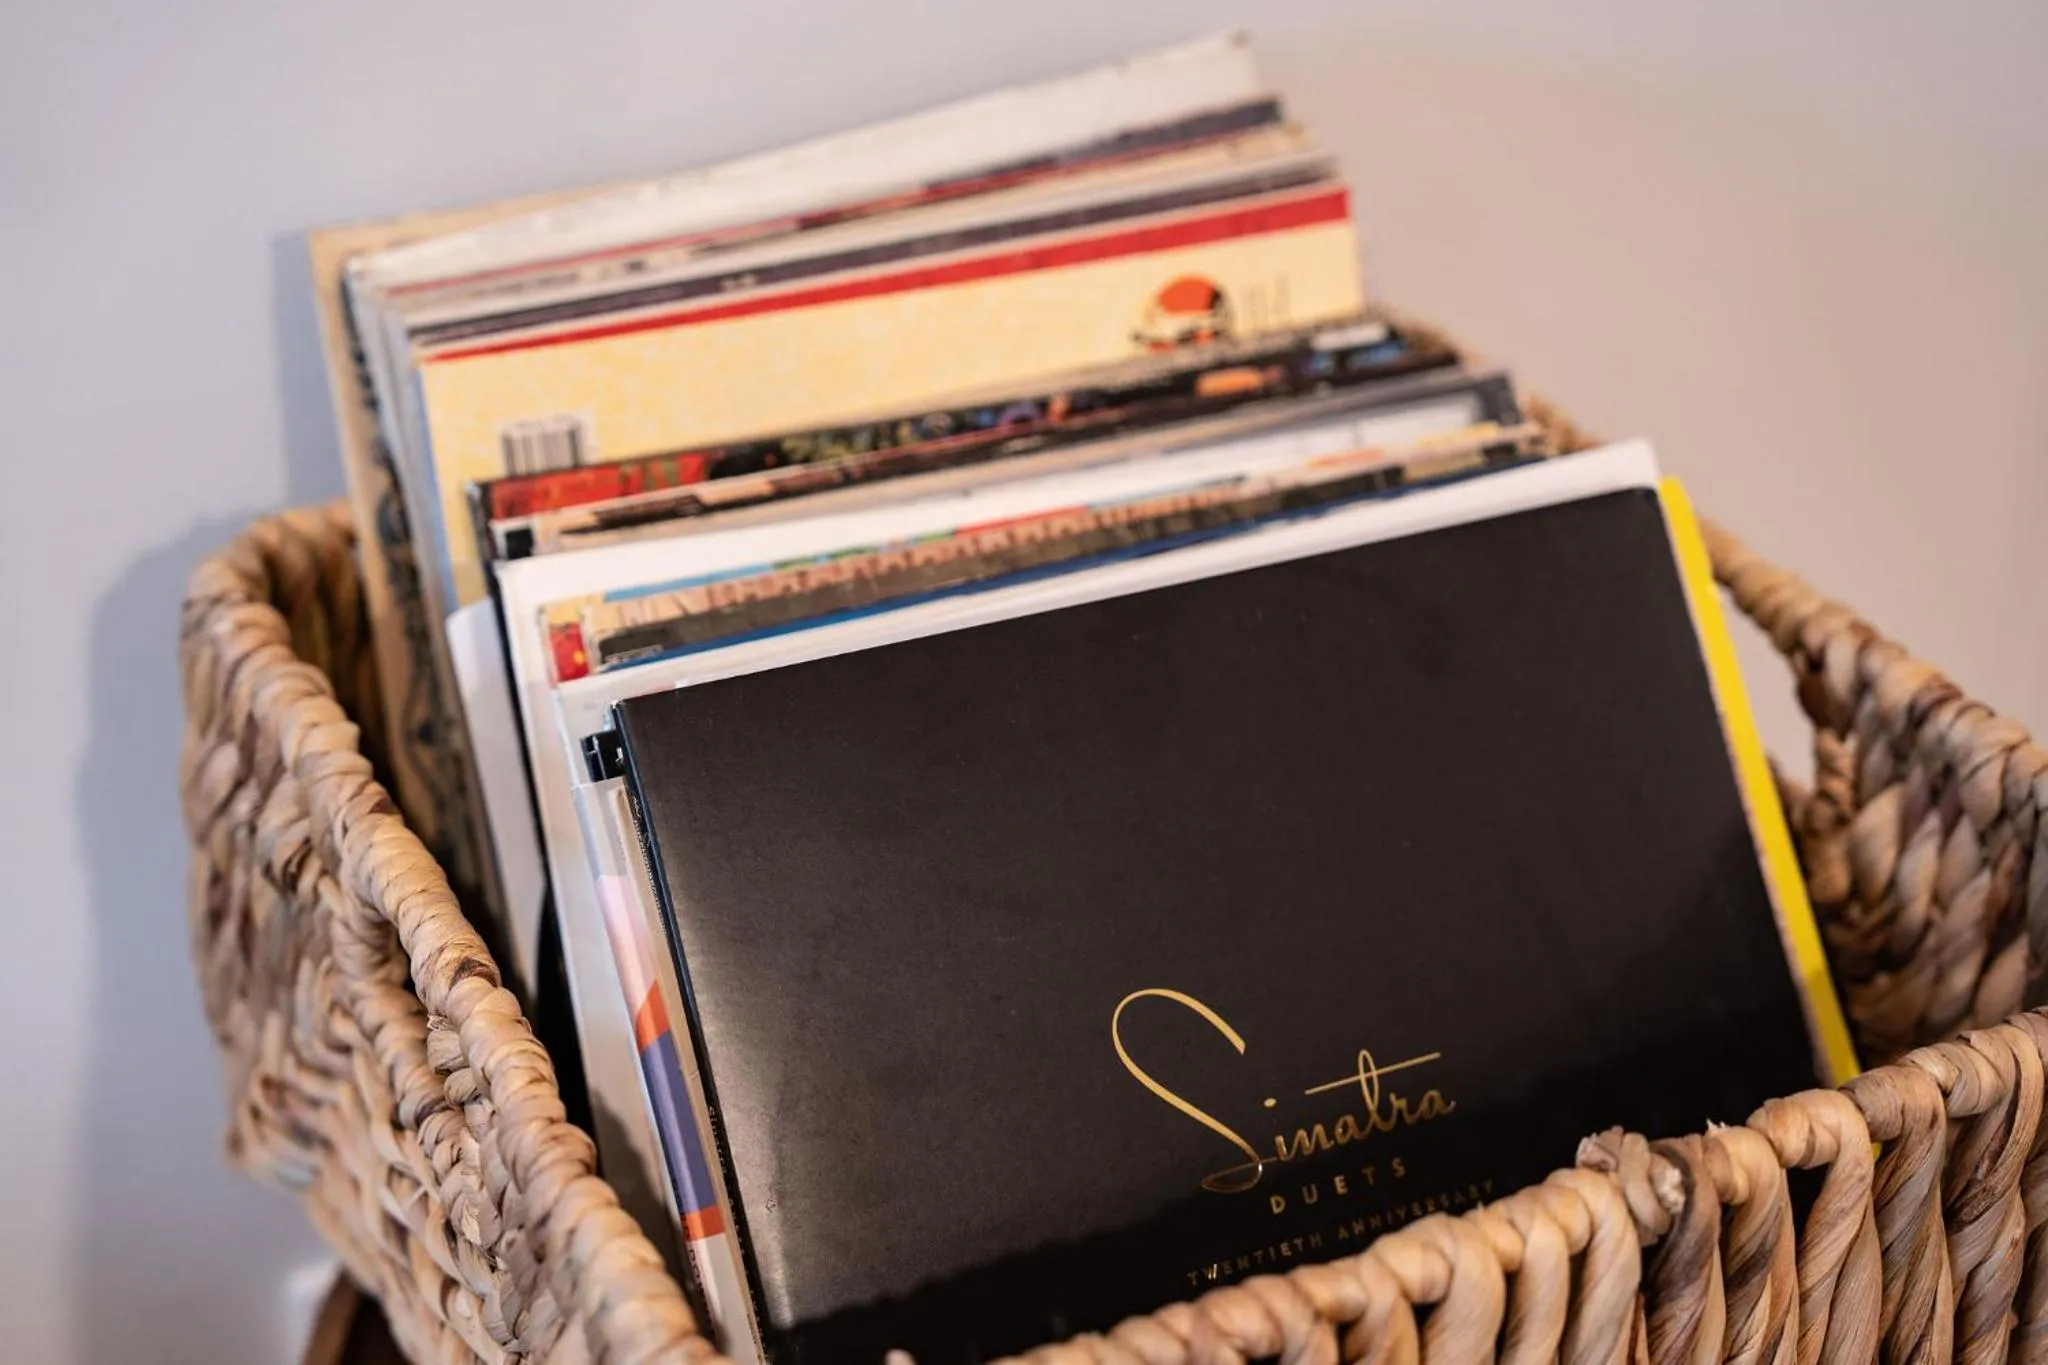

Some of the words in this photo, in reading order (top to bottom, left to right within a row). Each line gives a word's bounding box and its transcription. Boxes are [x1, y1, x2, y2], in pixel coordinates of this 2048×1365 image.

[1112, 988, 1456, 1193] Sinatra
[1187, 1233, 1323, 1286] TWENTIETH
[1338, 1179, 1493, 1240] ANNIVERSARY
[1270, 1157, 1406, 1214] DUETS
